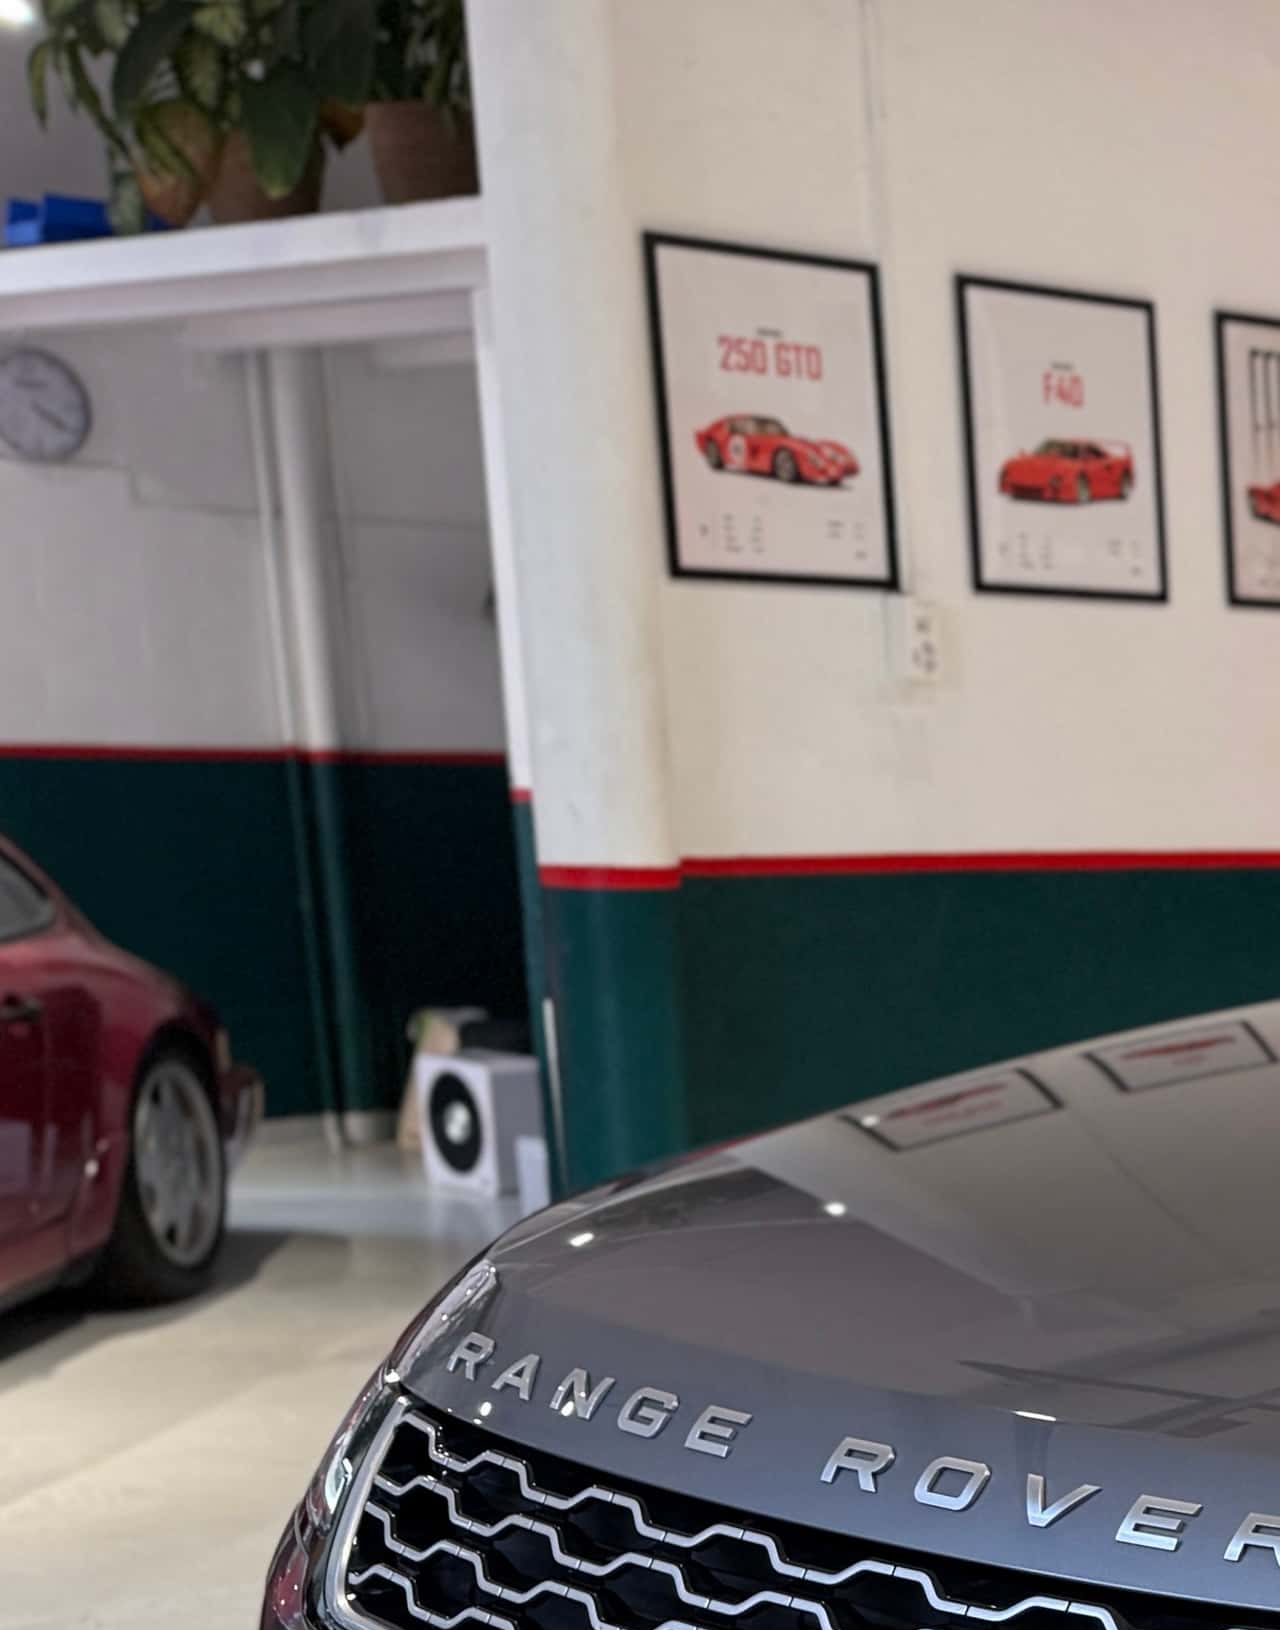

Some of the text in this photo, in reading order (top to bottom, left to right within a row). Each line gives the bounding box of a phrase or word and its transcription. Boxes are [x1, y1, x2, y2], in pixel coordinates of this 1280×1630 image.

[717, 335, 823, 381] 250 GTO
[1042, 371, 1084, 408] F40
[447, 1331, 753, 1458] RANGE
